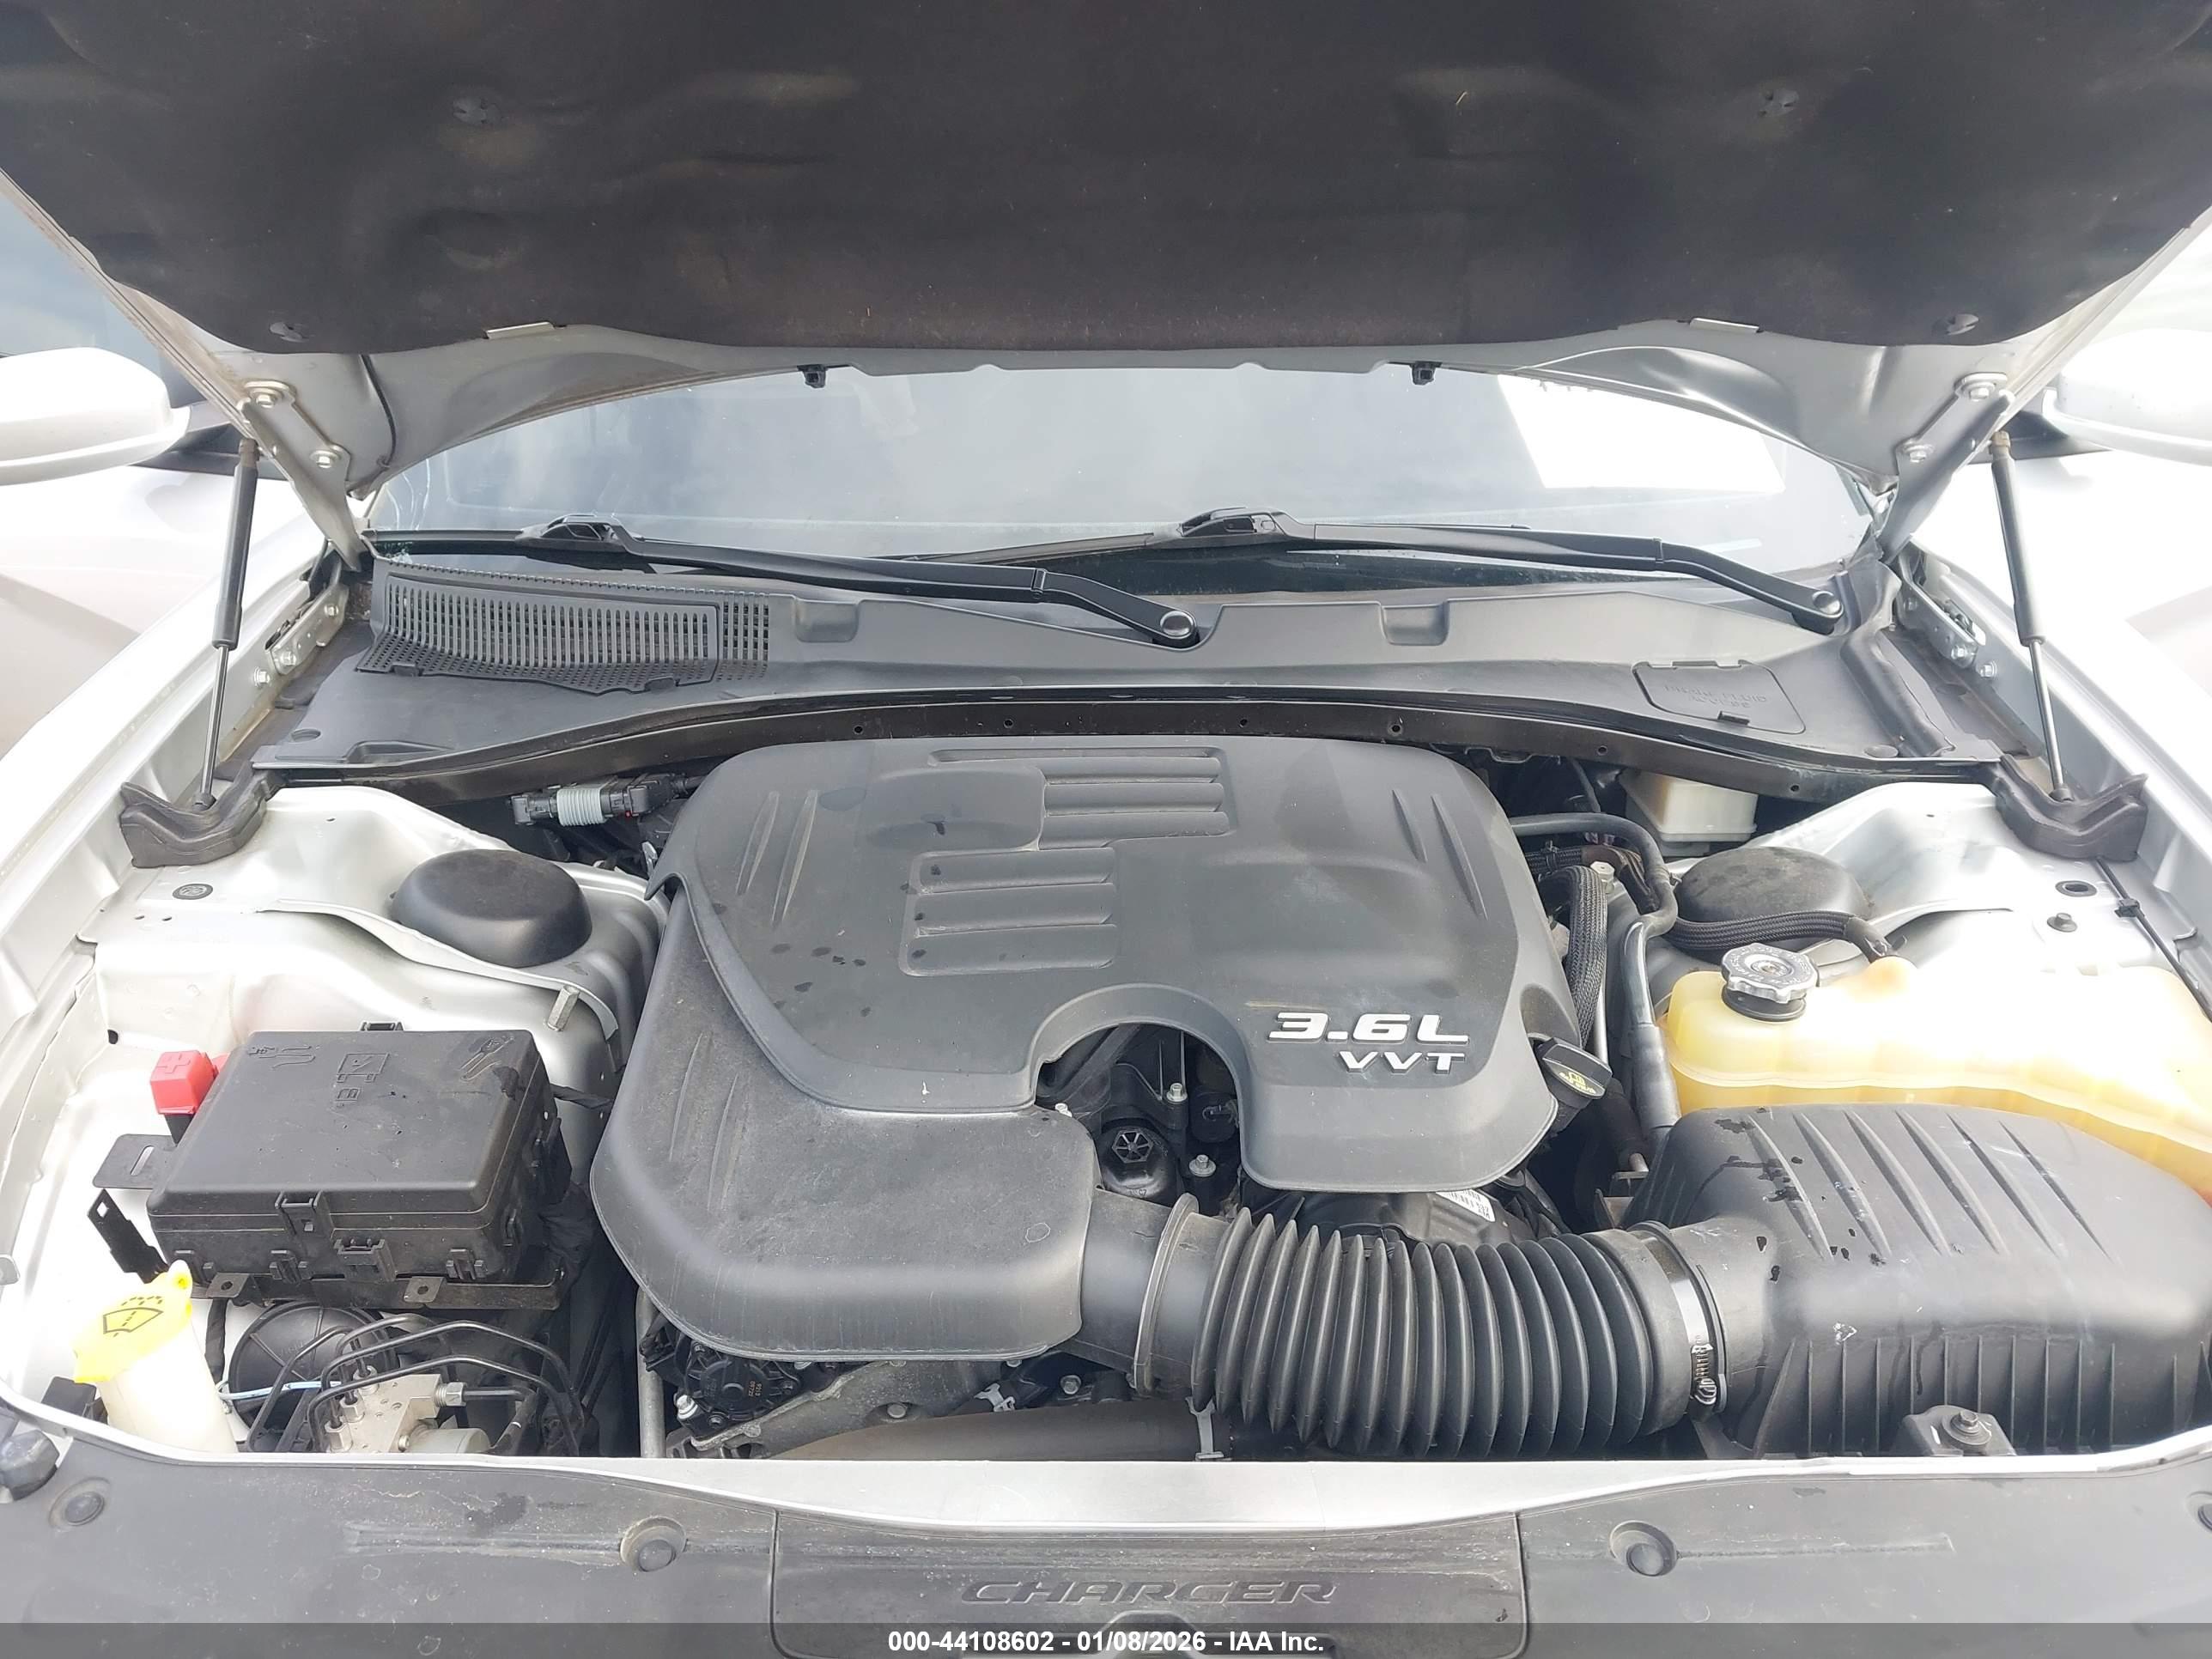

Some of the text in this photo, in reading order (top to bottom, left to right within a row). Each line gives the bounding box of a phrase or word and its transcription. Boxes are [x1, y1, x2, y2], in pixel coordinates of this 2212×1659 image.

[1267, 1012, 1469, 1044] 3.6L
[1337, 1051, 1466, 1074] VVT
[961, 1580, 1336, 1604] CHARGER
